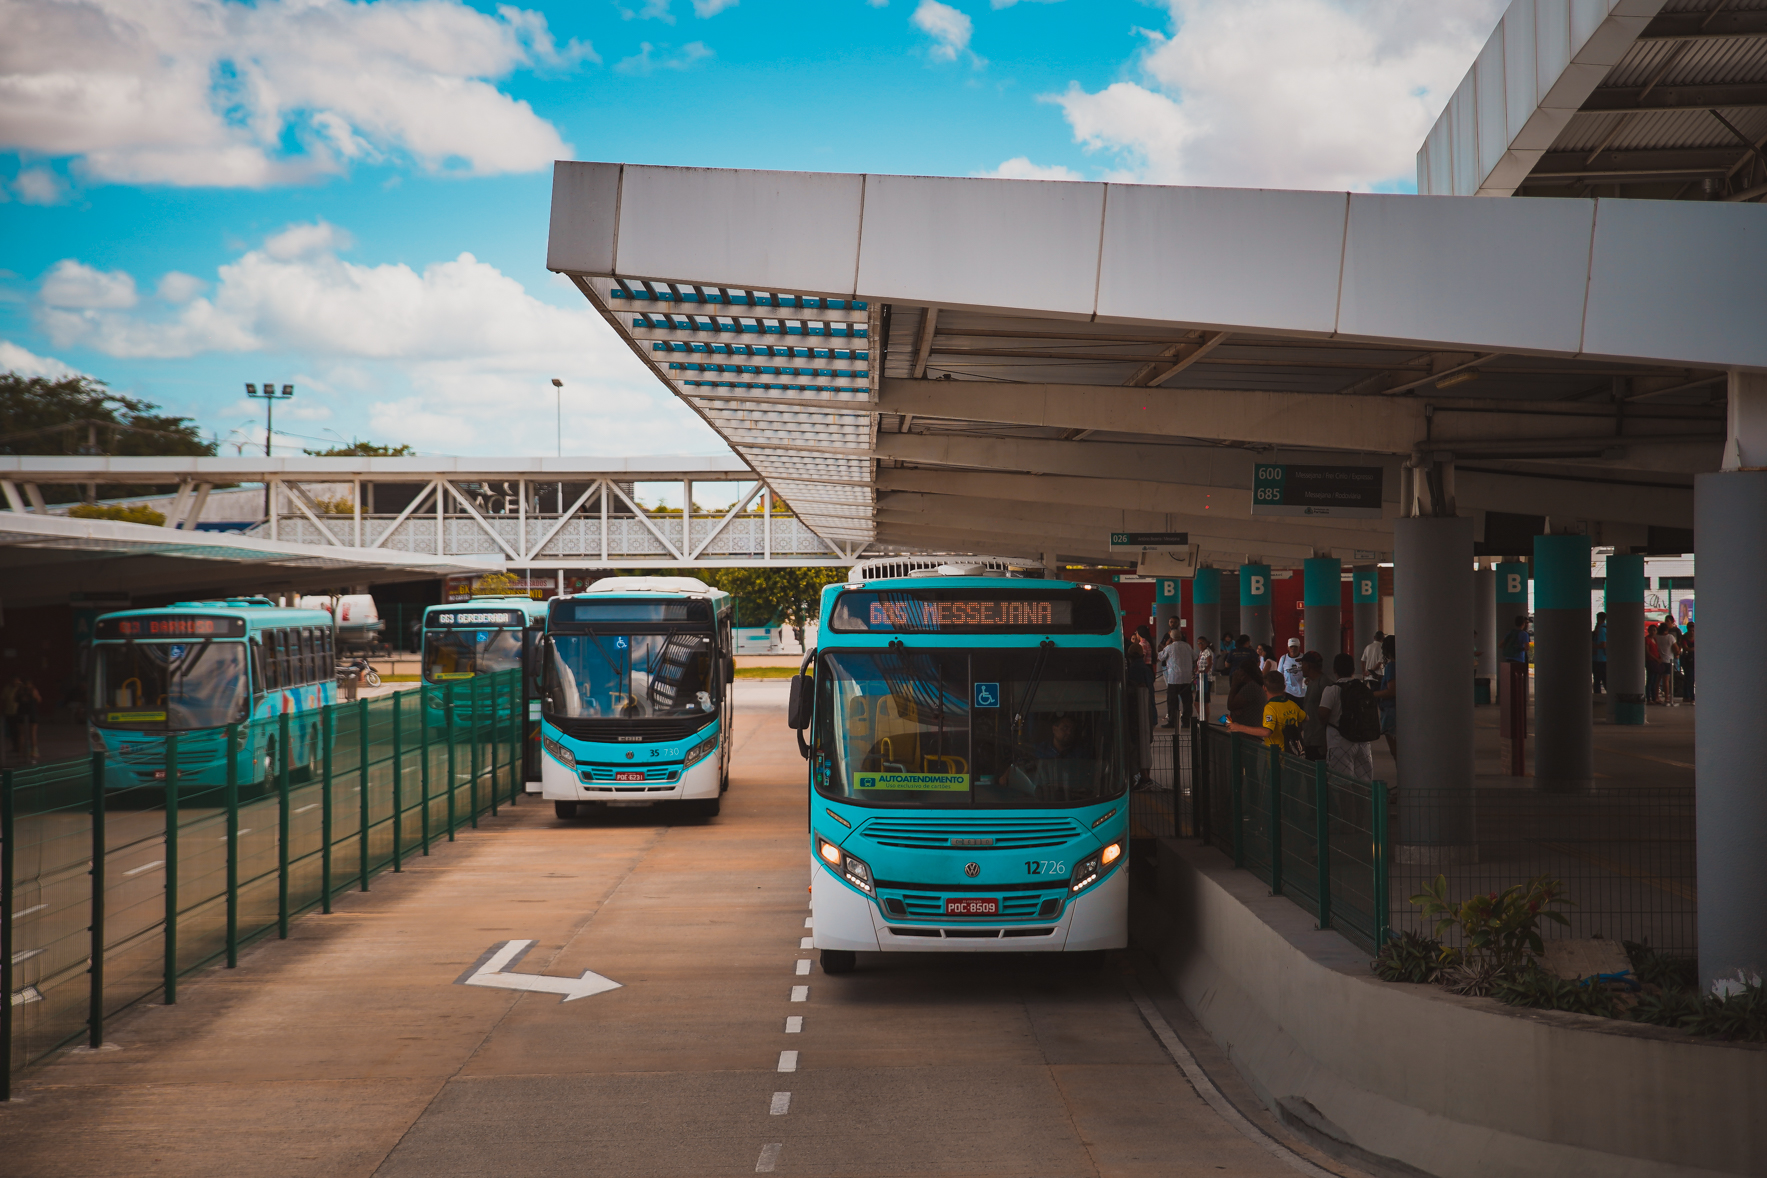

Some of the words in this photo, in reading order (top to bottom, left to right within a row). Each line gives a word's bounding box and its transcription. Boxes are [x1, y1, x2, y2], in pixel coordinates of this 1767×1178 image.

[1258, 468, 1282, 480] 600
[1295, 472, 1322, 480] Messejana
[1352, 473, 1374, 481] Expresso
[1257, 488, 1280, 500] 685
[1304, 491, 1331, 499] Messejana
[1164, 581, 1175, 596] B
[1250, 576, 1264, 595] B
[1361, 580, 1372, 595] B
[1507, 574, 1522, 593] B
[924, 602, 1052, 624] MESSEJANA
[150, 620, 214, 633] BARROSO
[664, 748, 679, 756] 730
[878, 775, 964, 784] AUTOATENDIMENTO
[1024, 860, 1066, 874] 12726
